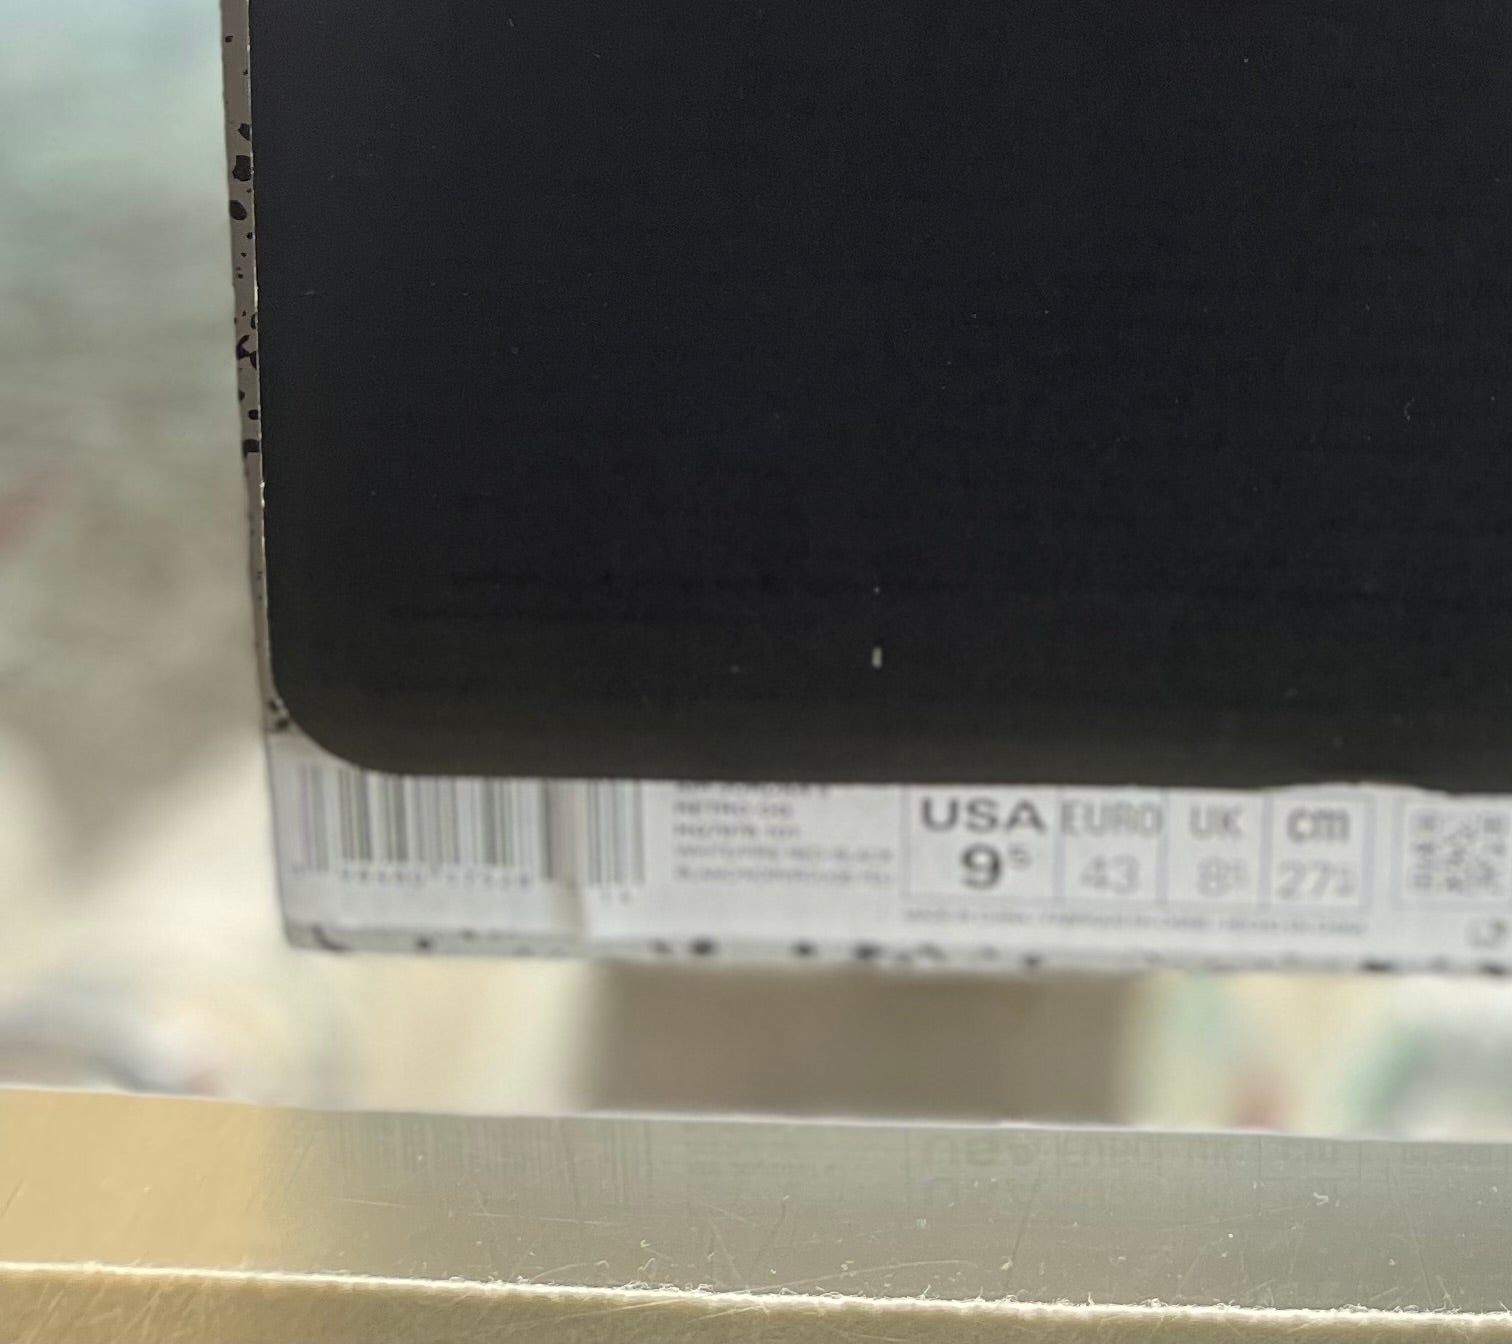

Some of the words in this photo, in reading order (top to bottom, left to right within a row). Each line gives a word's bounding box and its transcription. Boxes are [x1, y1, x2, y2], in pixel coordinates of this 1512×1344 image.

[918, 796, 1047, 835] USA
[1060, 799, 1163, 838] EURO
[1189, 803, 1244, 839] UK
[1286, 808, 1351, 844] cm
[1079, 854, 1140, 895] 43
